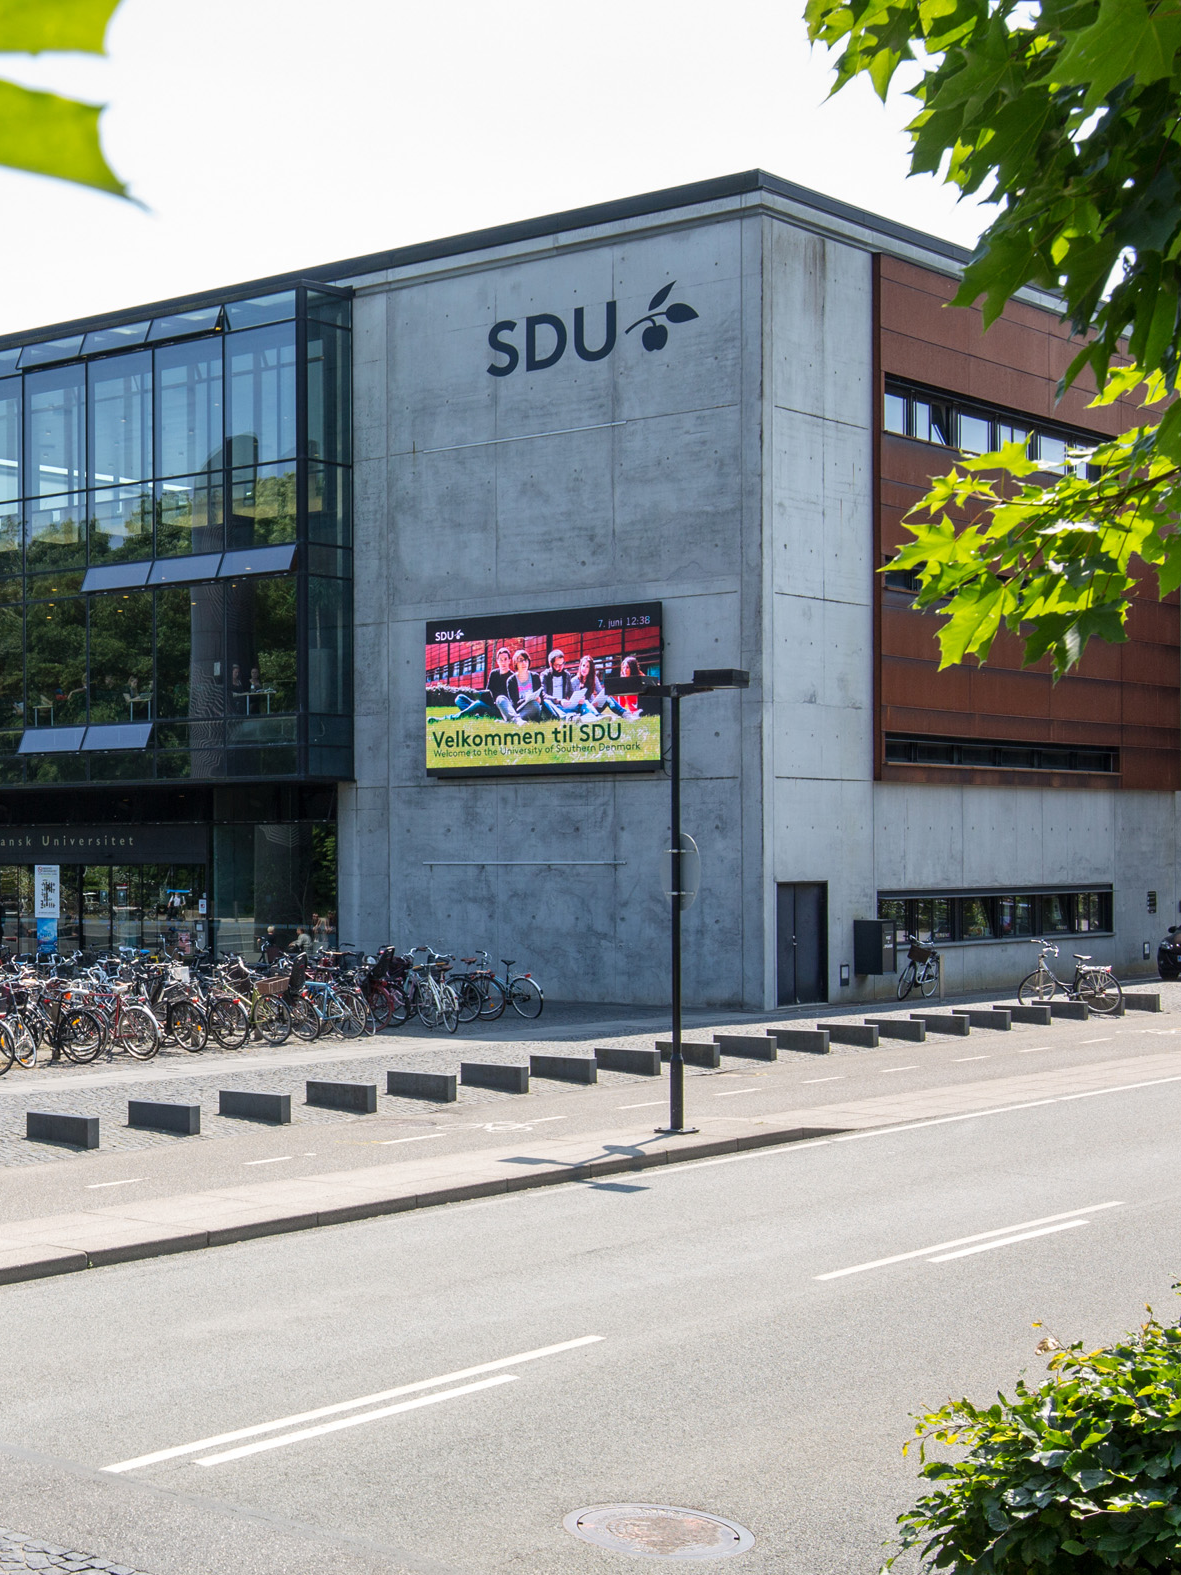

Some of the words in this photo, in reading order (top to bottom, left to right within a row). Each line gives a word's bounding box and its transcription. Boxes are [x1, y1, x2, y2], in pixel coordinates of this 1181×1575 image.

[486, 299, 617, 378] SDU
[598, 619, 606, 628] 7.
[608, 618, 623, 629] juni
[626, 615, 651, 626] 12:38
[435, 630, 454, 641] SDU
[432, 729, 545, 748] Velkommen
[551, 724, 573, 743] til
[579, 722, 622, 742] SDU
[433, 748, 471, 757] Welcome
[473, 748, 482, 757] to
[484, 747, 498, 756] the
[500, 745, 543, 756] University
[544, 743, 555, 754] of
[556, 743, 596, 753] Southern
[599, 741, 641, 752] Denmark
[41, 835, 134, 846] Universitet
